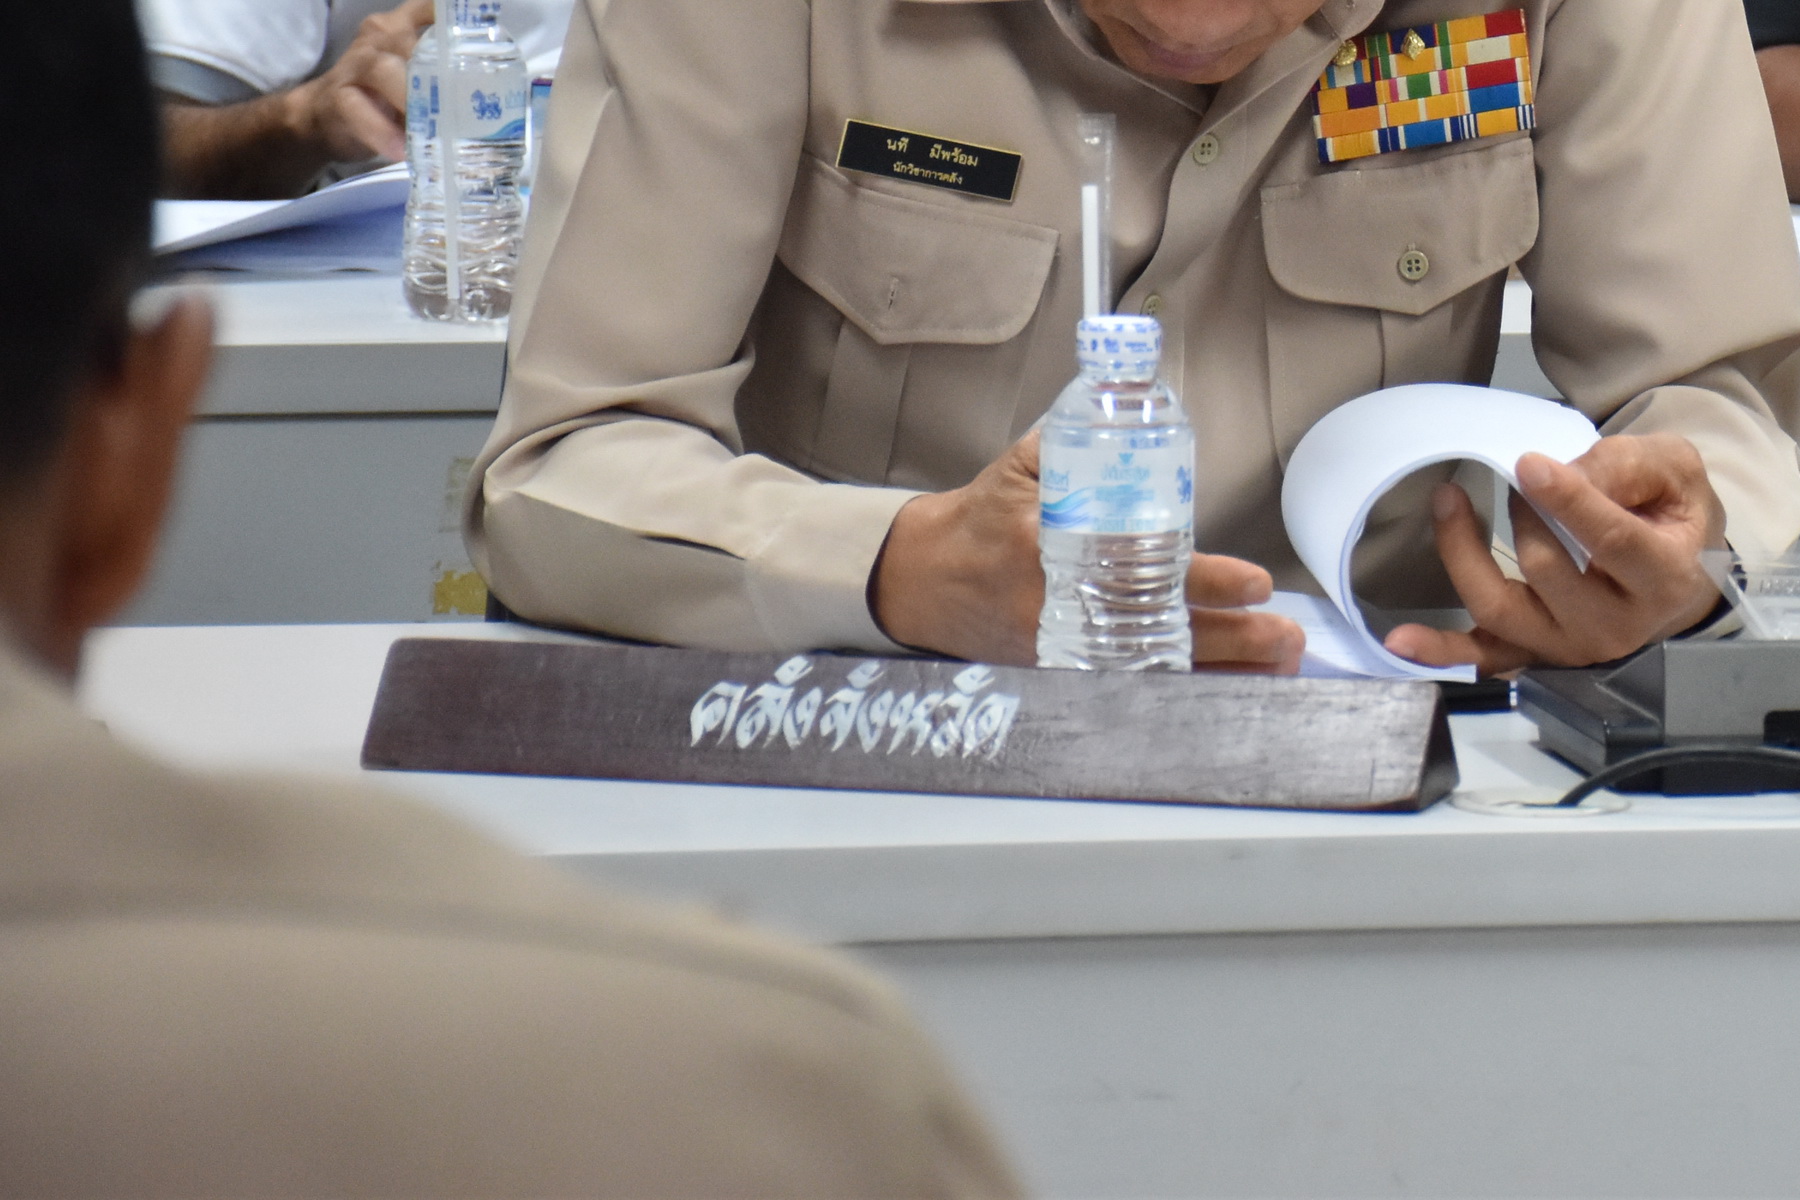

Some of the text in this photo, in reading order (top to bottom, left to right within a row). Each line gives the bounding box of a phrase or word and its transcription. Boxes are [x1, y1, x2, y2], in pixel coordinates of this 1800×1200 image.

[886, 137, 979, 168] นที มีพร้อม
[689, 655, 1022, 761] คลังจังหวัด
